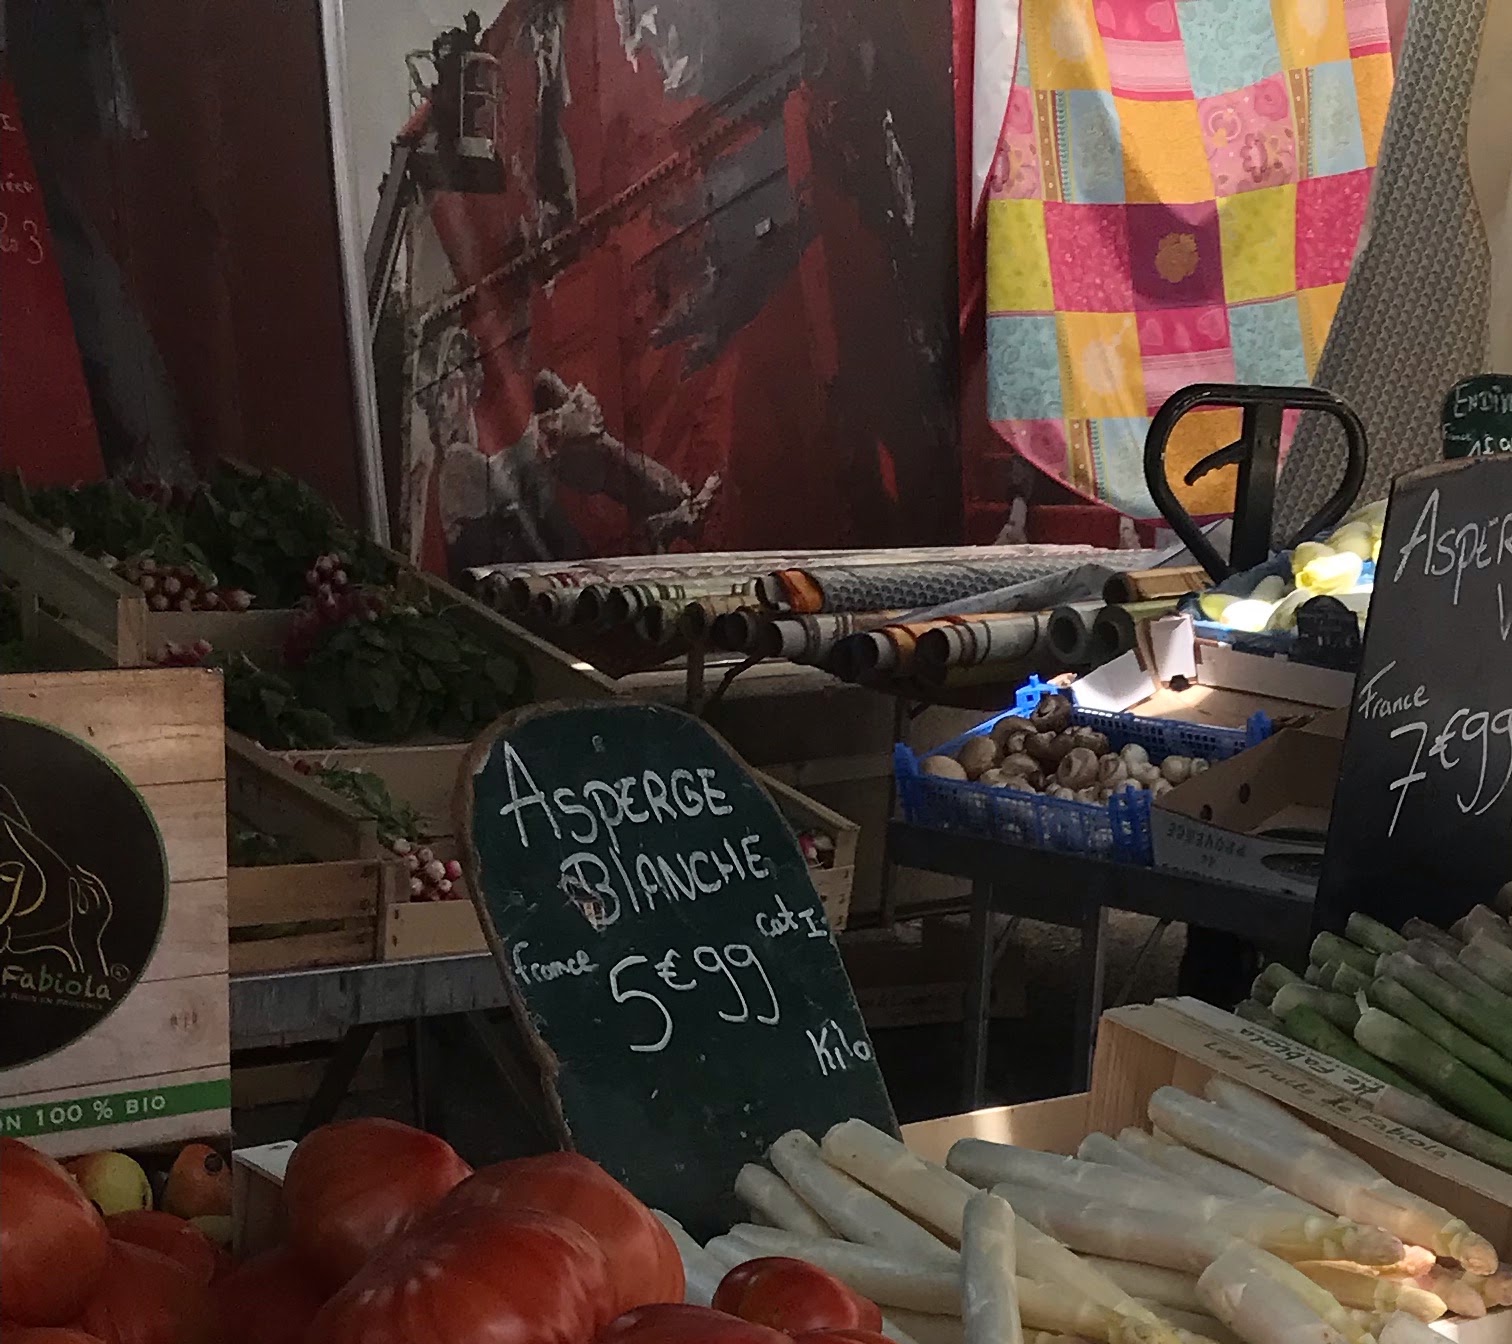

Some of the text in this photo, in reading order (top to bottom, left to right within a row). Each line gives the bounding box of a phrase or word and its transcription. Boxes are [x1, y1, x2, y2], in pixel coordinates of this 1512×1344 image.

[1358, 661, 1430, 719] France
[500, 741, 734, 854] ASPERGE
[609, 944, 873, 1077] 5€99 Kilo
[36, 1104, 84, 1127] 100
[125, 1095, 167, 1115] BIO
